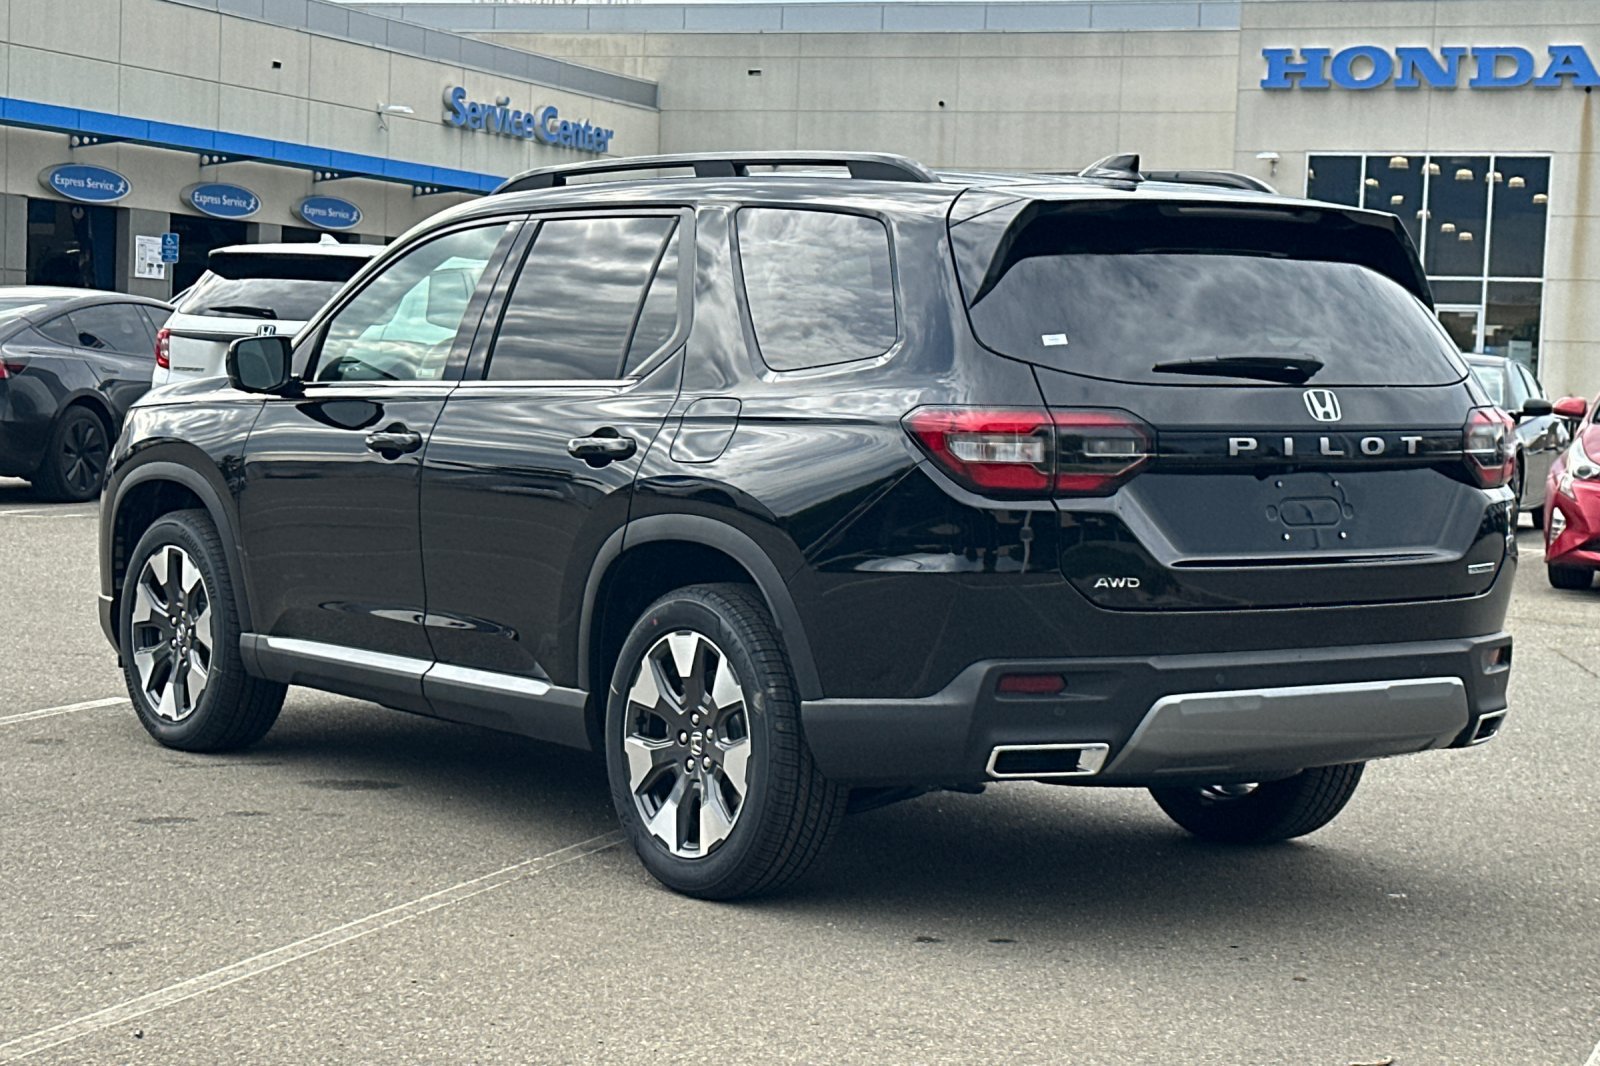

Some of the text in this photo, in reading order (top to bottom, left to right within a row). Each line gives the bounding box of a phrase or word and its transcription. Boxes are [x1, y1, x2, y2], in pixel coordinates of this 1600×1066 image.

[1260, 45, 1600, 90] HONDA
[443, 84, 614, 153] Service Center
[54, 173, 114, 191] Express Service
[194, 191, 247, 208] Express Service
[1228, 436, 1423, 457] PILOT
[1093, 577, 1140, 588] AWD
